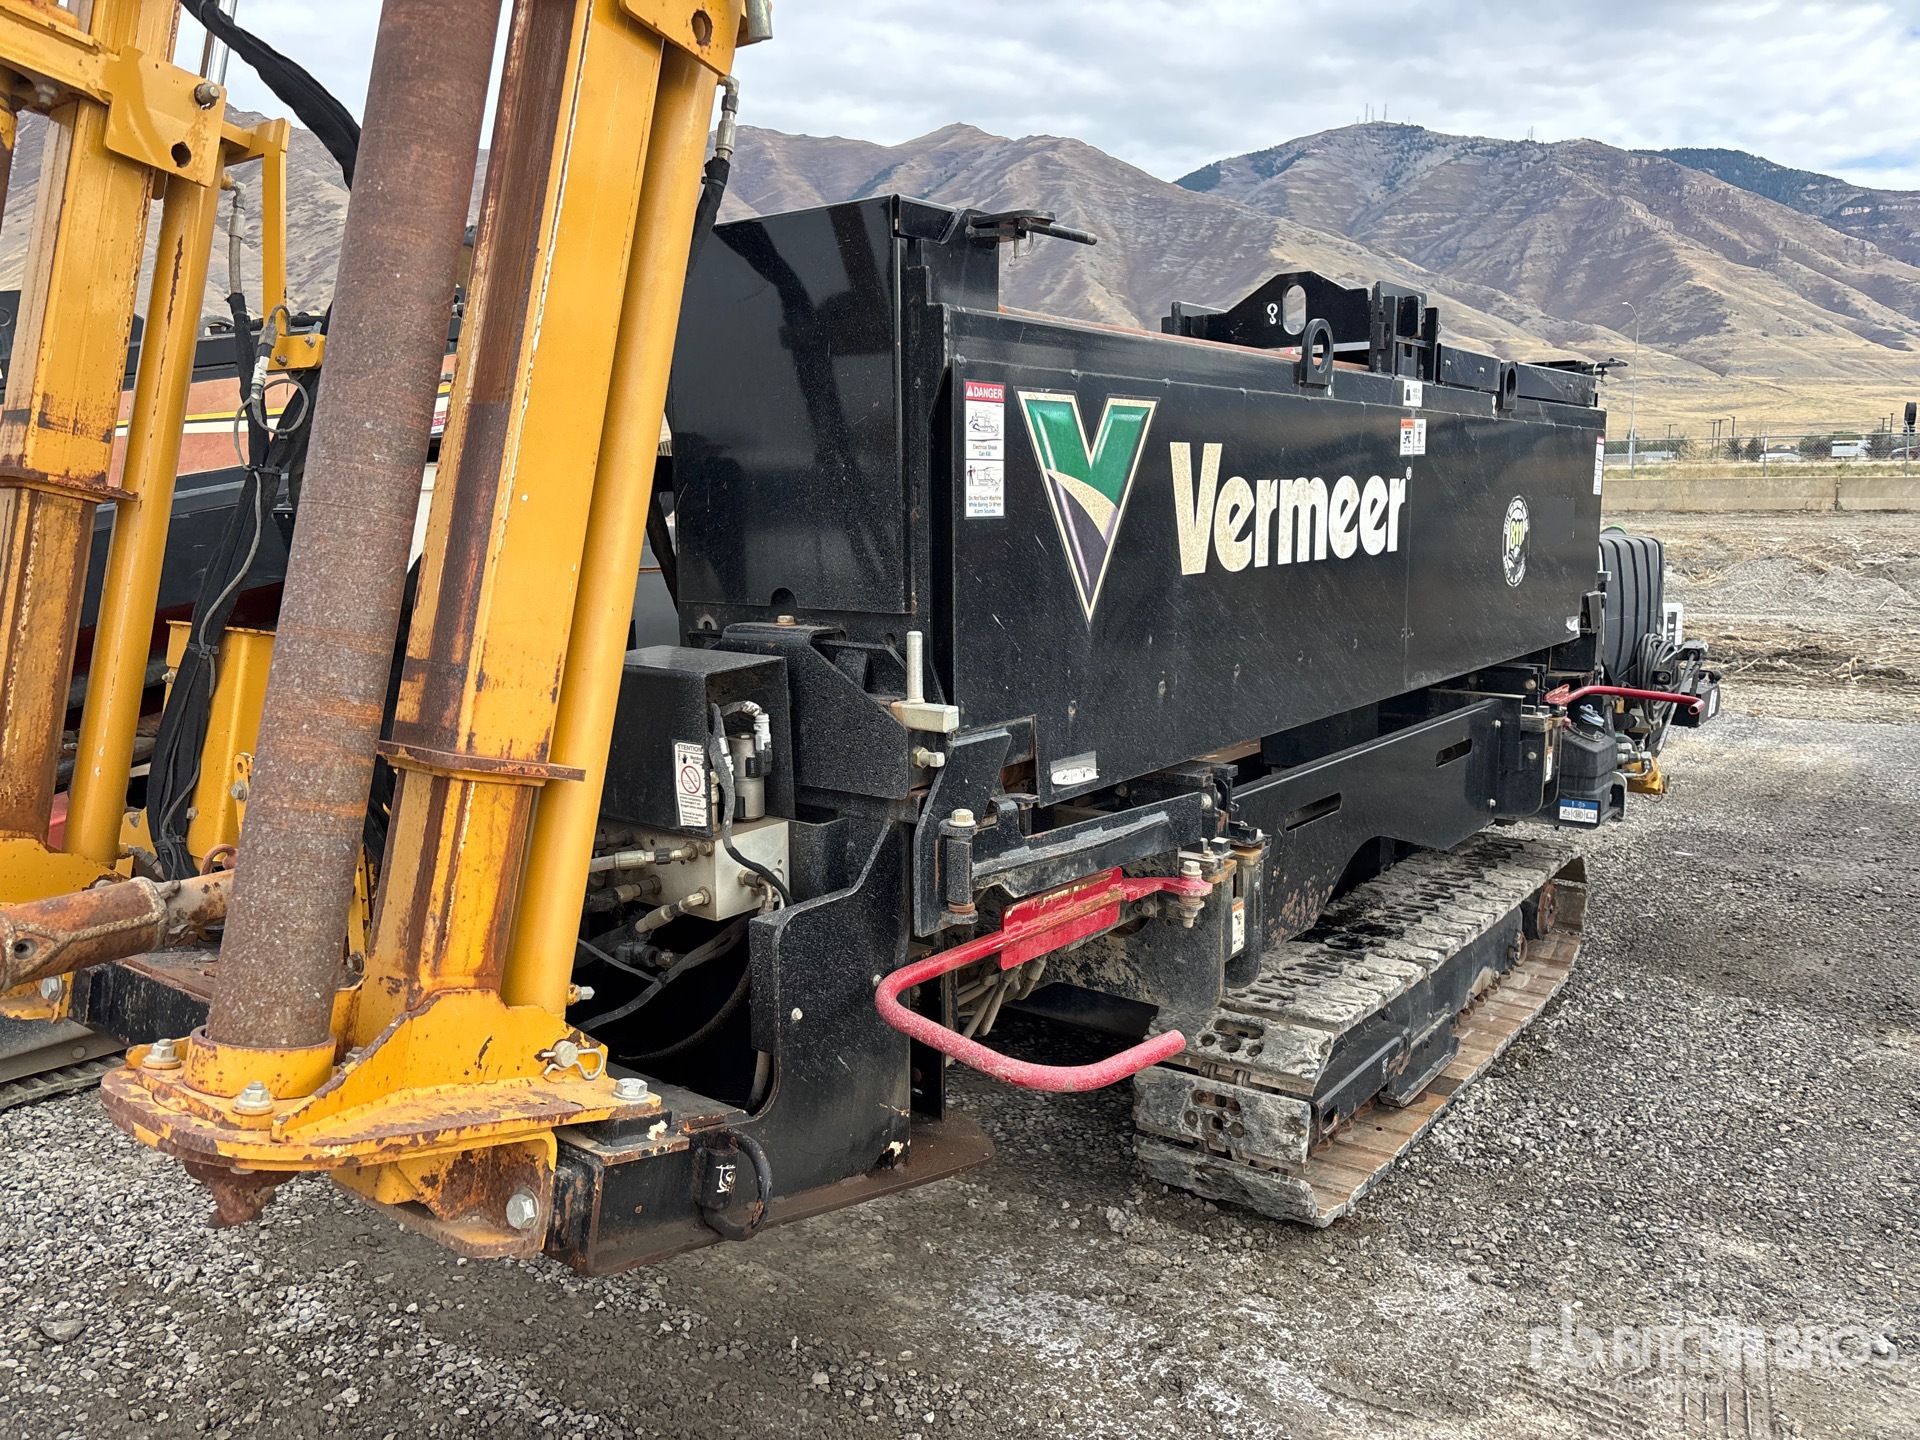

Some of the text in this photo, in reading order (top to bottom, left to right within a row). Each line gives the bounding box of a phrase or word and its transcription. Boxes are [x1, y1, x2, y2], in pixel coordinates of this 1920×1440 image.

[974, 386, 1003, 399] DANGER
[1170, 442, 1406, 575] Vermeer
[1510, 520, 1524, 550] 811
